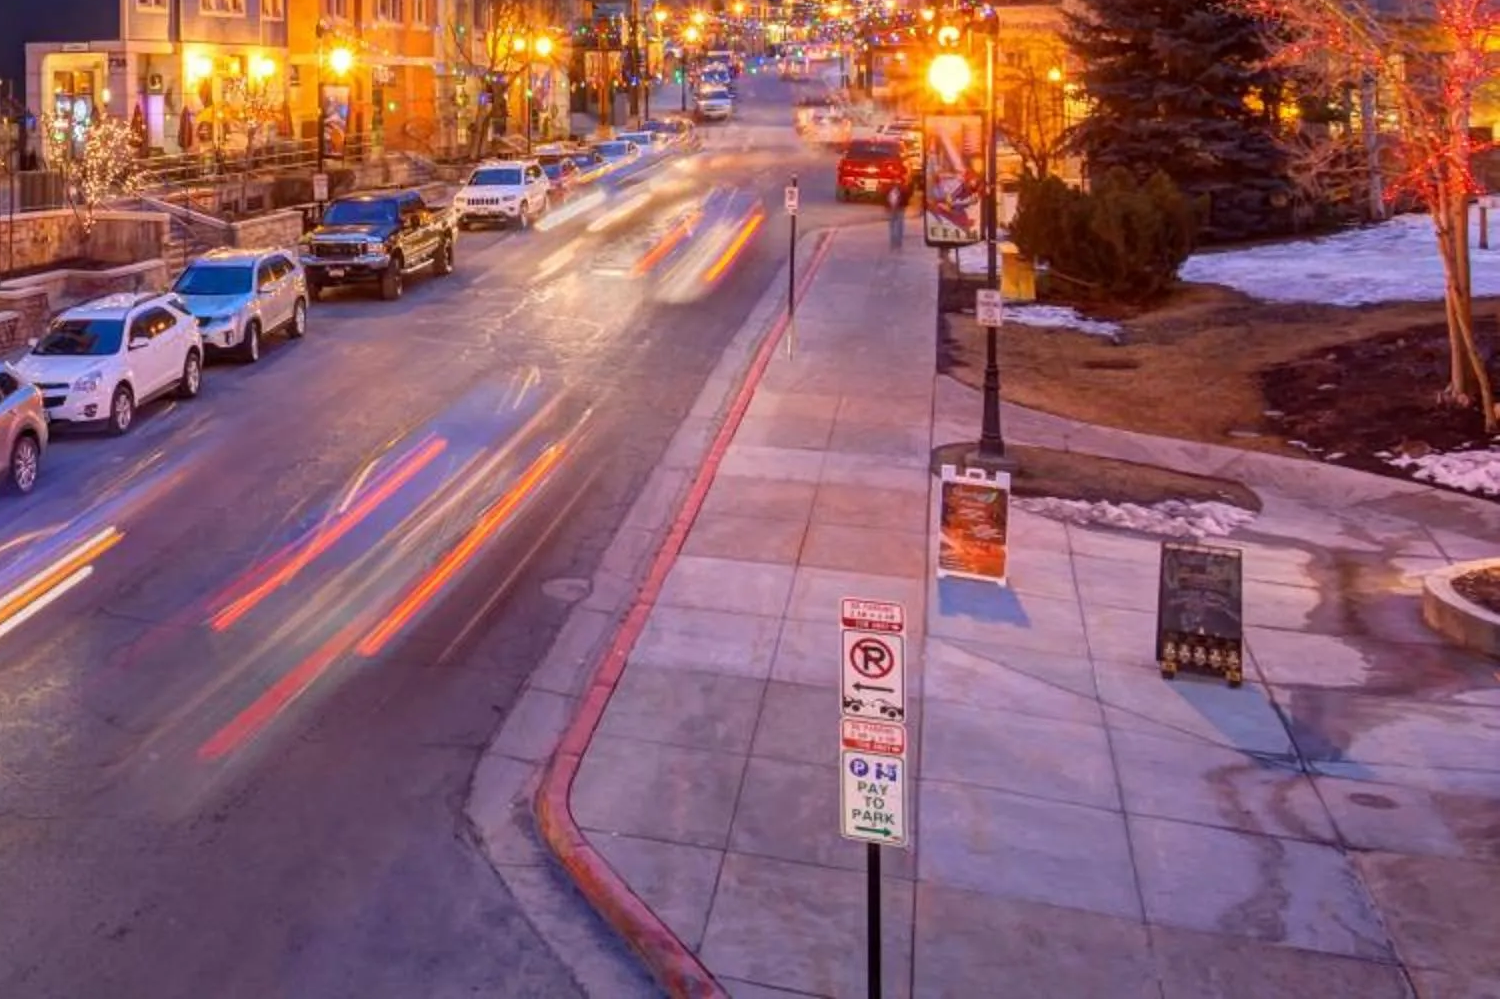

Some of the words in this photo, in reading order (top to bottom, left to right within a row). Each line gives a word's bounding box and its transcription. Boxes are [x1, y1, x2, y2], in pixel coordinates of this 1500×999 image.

[858, 782, 888, 795] PAY
[865, 796, 885, 809] TO
[852, 809, 895, 825] PARK
